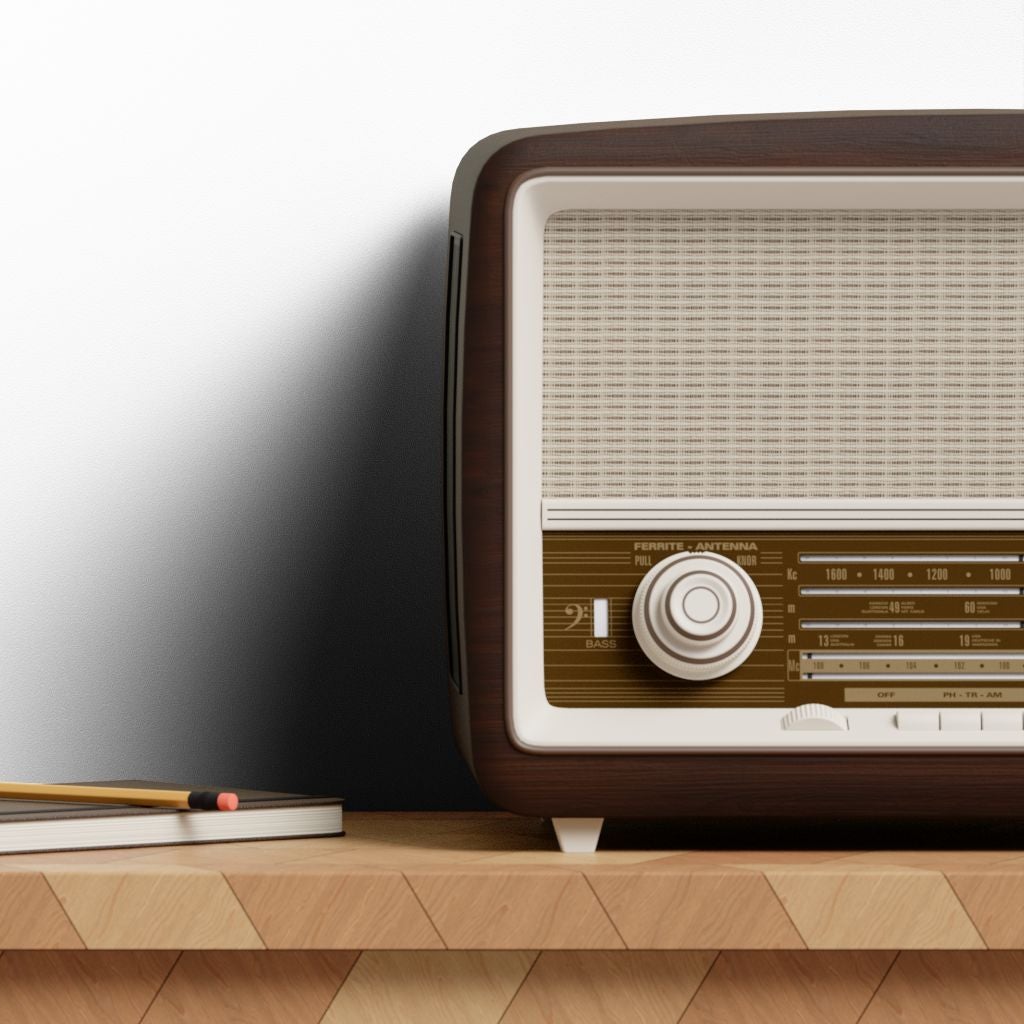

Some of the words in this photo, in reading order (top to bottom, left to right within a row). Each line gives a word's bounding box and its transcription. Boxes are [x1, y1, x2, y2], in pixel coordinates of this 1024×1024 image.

[634, 542, 684, 551] FERRITE
[696, 542, 758, 551] ANTENNA
[634, 555, 652, 566] PULL
[825, 568, 848, 581] 1600
[873, 568, 895, 581] 1400
[926, 568, 948, 581] 1200
[989, 568, 1012, 581] 1000
[889, 601, 900, 614] 49
[964, 601, 976, 614] 60
[586, 640, 617, 649] BASS
[818, 634, 830, 647] 13
[893, 634, 904, 647] 16
[959, 634, 970, 647] 19
